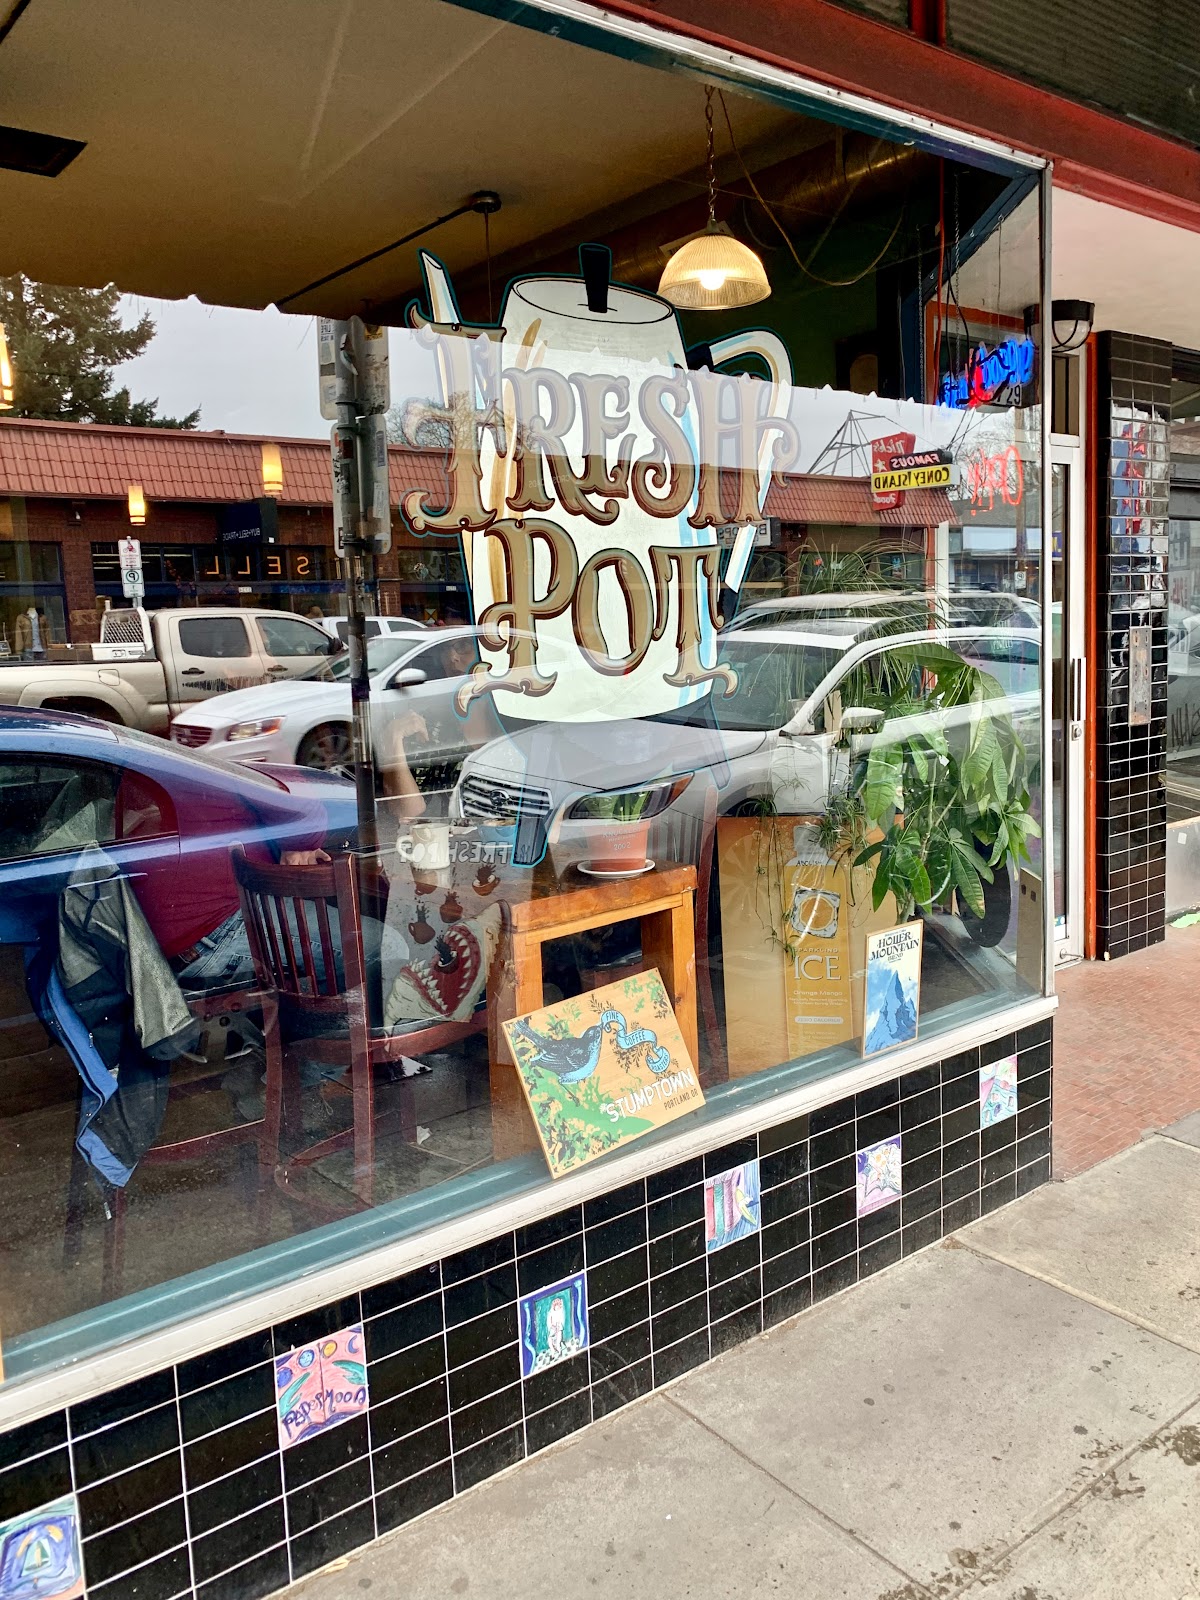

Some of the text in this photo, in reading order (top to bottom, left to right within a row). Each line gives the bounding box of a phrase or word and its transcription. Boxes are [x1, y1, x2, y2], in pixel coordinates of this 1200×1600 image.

[400, 302, 799, 536] FRESH
[454, 517, 740, 719] POT
[869, 938, 920, 961] MOUNTAIN
[793, 954, 841, 981] ICE
[605, 1010, 621, 1022] FINE
[624, 1030, 647, 1046] COFFEE
[606, 1067, 695, 1123] STUMPTOWN
